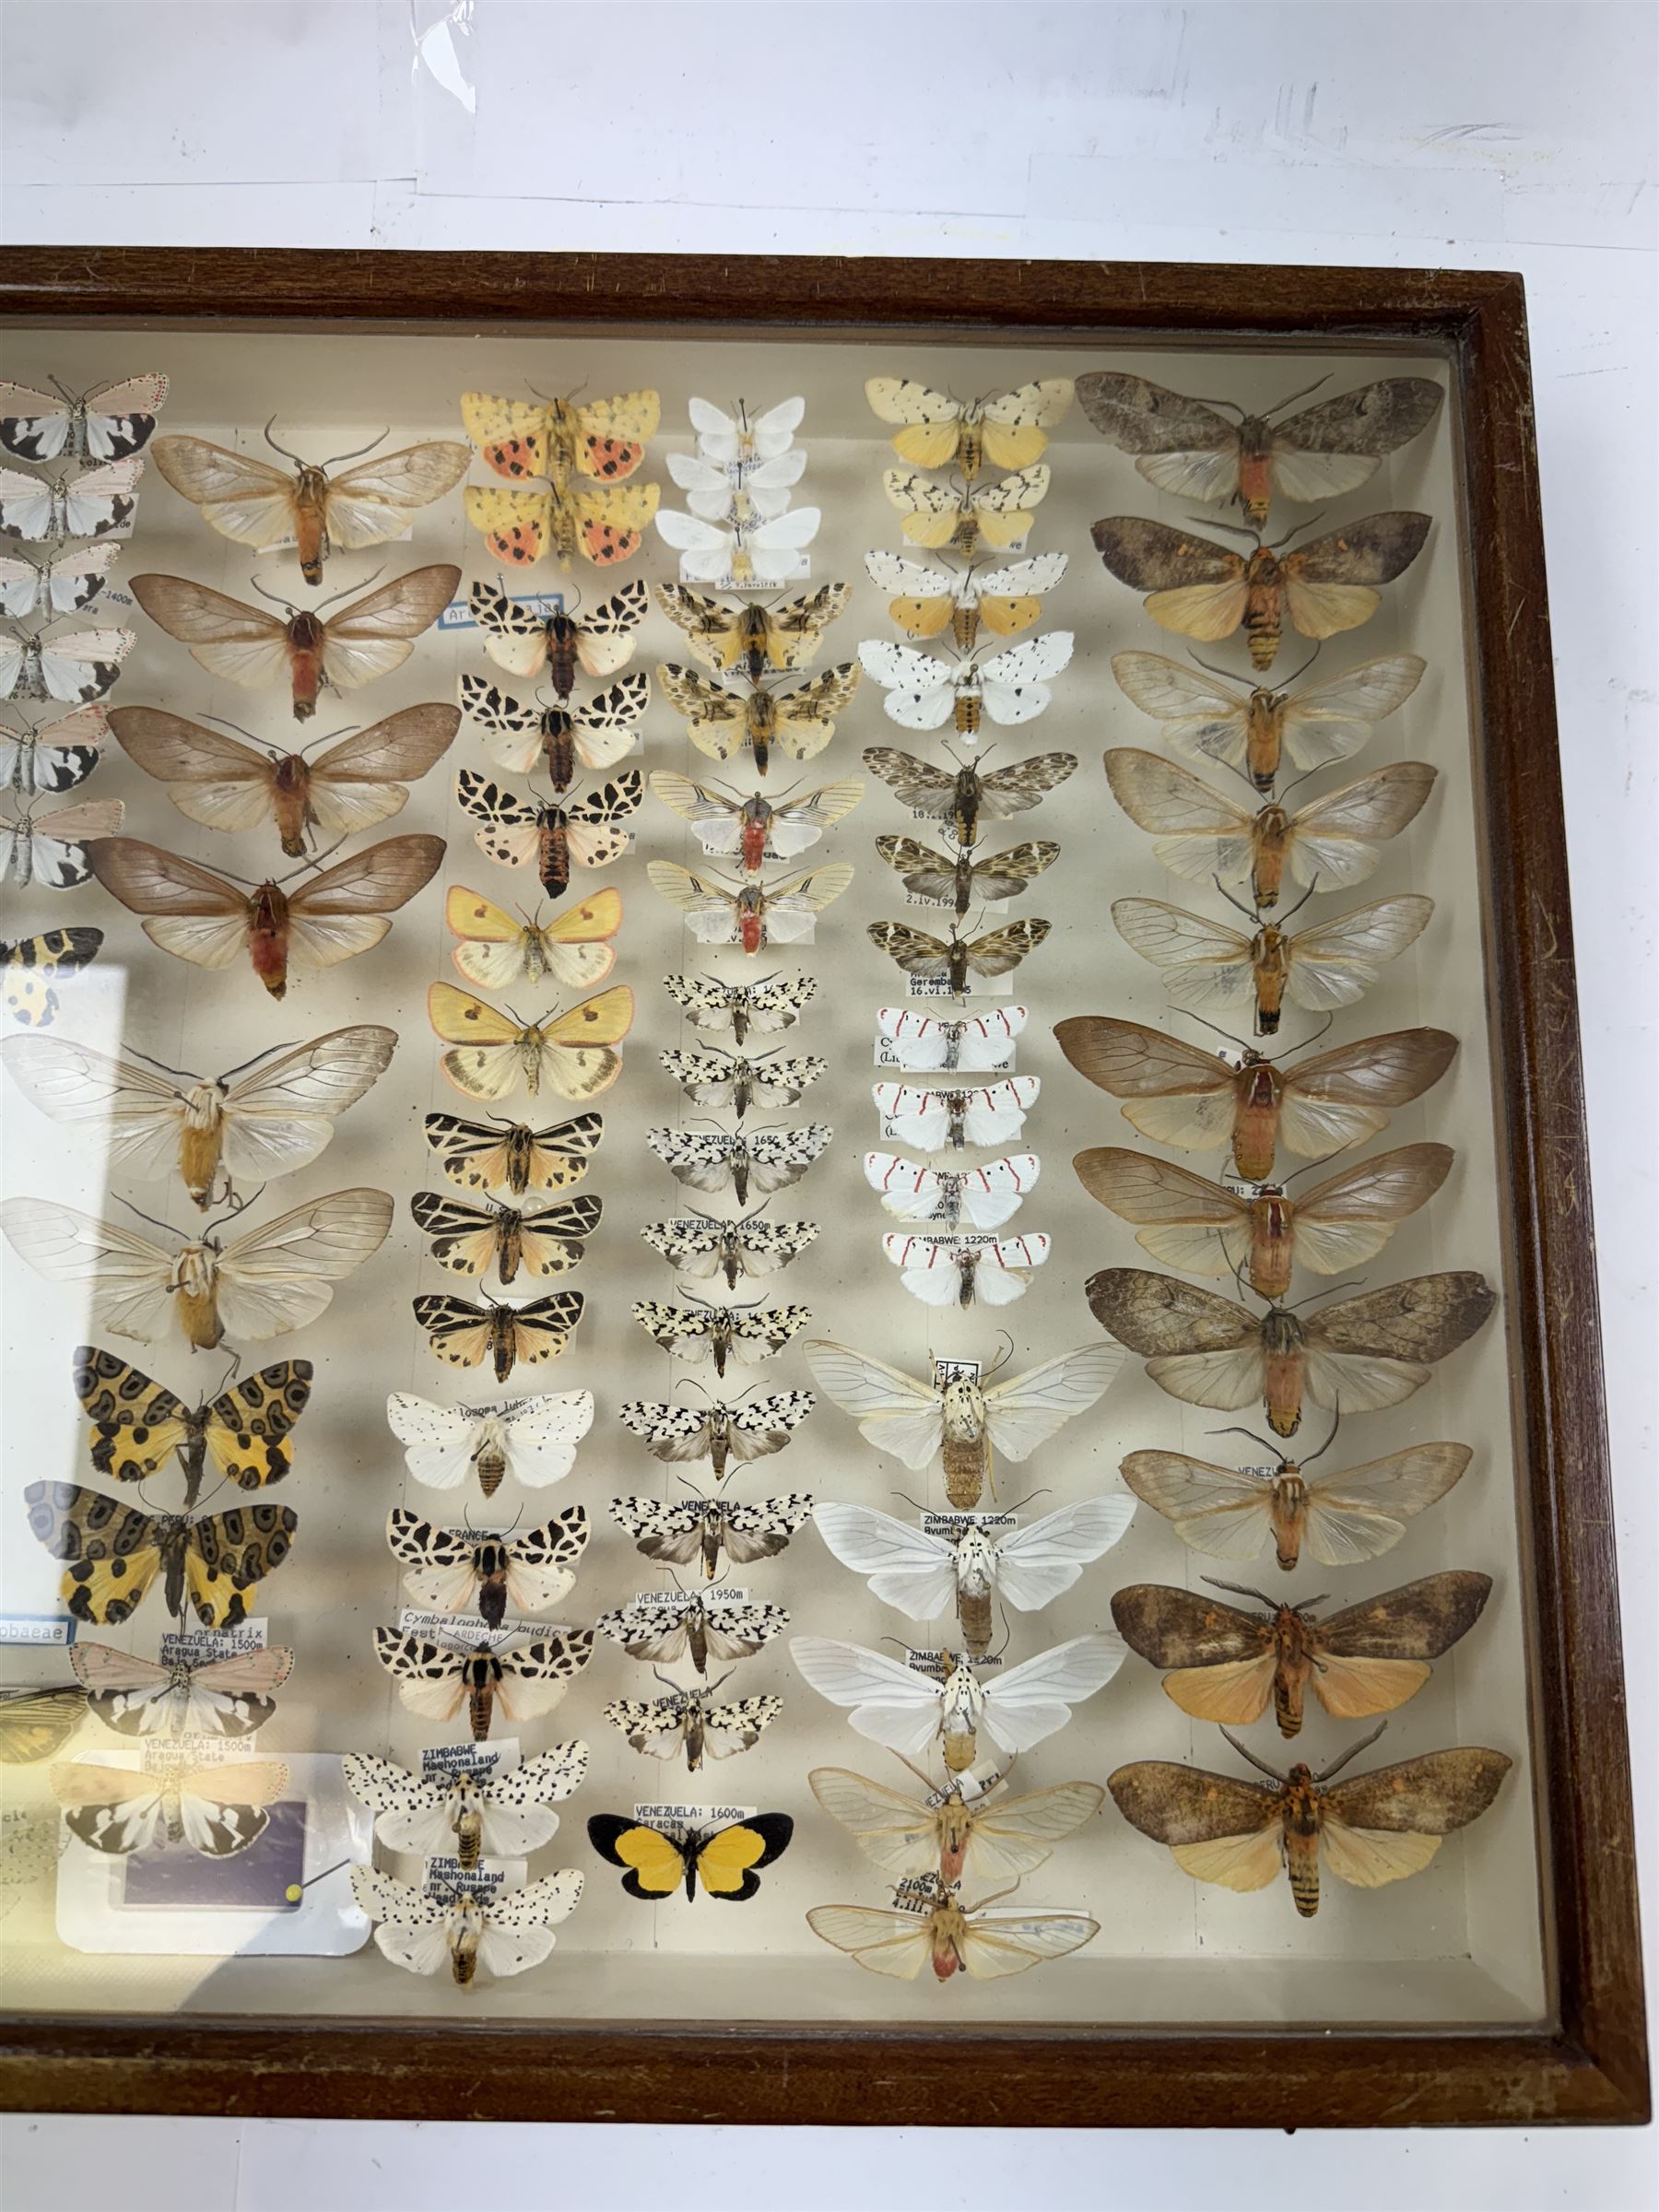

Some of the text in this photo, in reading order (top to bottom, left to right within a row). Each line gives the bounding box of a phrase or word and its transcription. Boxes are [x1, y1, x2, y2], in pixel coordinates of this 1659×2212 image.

[906, 894, 957, 908] 2.iv.199
[964, 1235, 997, 1244] 1220m
[681, 1500, 741, 1512] VENEUELA
[710, 1589, 744, 1600] 1950m
[161, 1633, 264, 1651] VENEZUELA: 1500m
[160, 1645, 238, 1659] Aragua State
[144, 1738, 252, 1752] VENEZUELA: 1500m
[422, 1744, 477, 1760] ZIMBABWE
[192, 1751, 225, 1762] State
[422, 1752, 500, 1771] Mashonaland
[636, 1806, 745, 1819] VENEZUELA: 1600m
[430, 1857, 485, 1870] ZIMBE
[429, 1868, 505, 1882] Mashonaland
